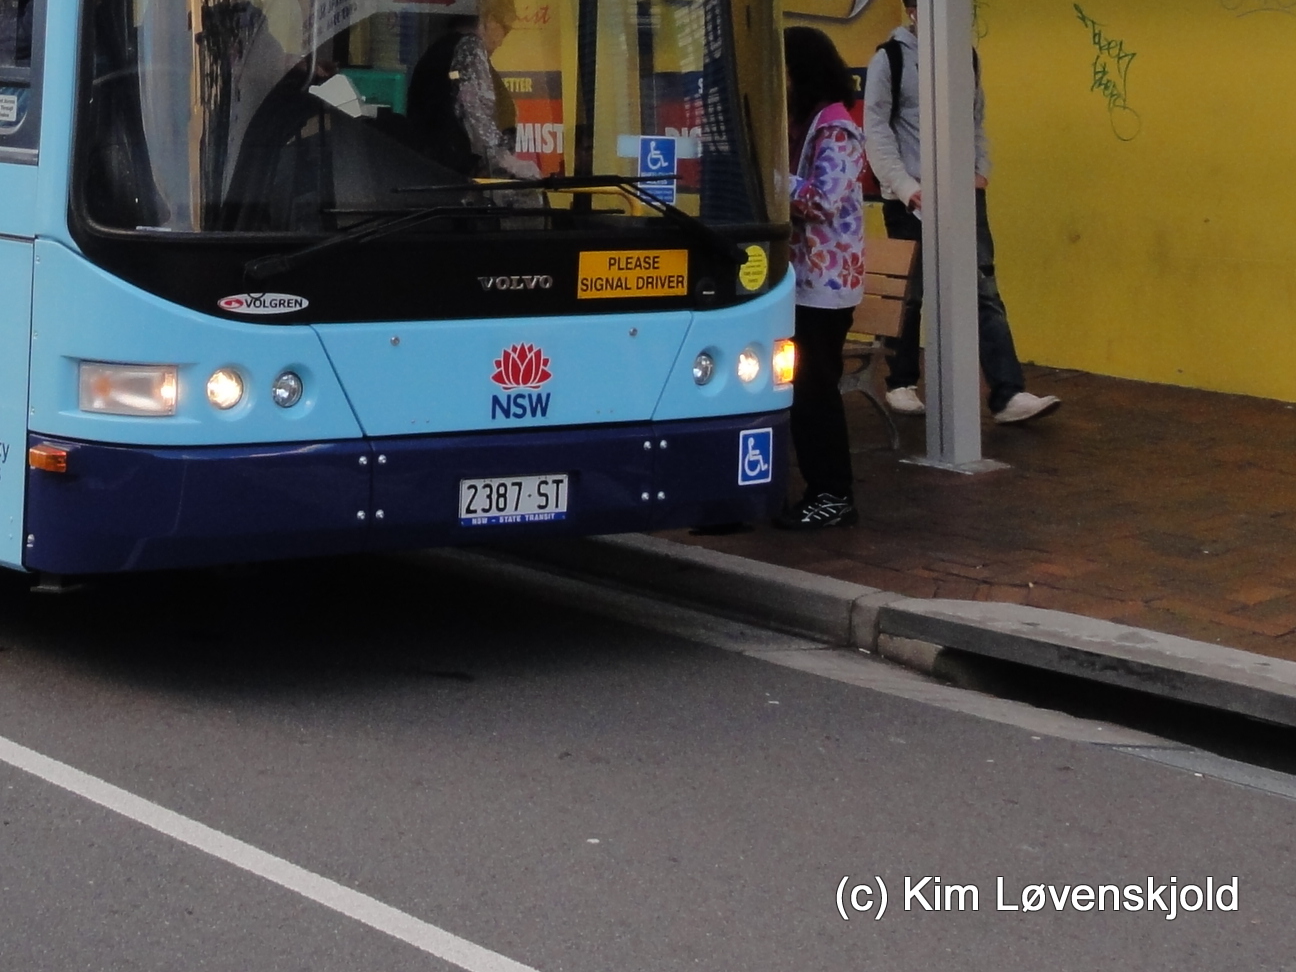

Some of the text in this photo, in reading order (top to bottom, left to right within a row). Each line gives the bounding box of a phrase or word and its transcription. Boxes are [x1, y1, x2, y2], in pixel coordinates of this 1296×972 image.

[503, 77, 533, 93] ETTER
[607, 255, 661, 271] PLEASE
[477, 274, 554, 291] VOLVO
[580, 274, 685, 293] SIGNAL DRIVER
[245, 298, 304, 309] VOLGREN
[491, 392, 551, 420] NSW
[471, 517, 488, 525] NSW
[499, 515, 522, 523] STATE
[525, 512, 556, 522] TRANSIT
